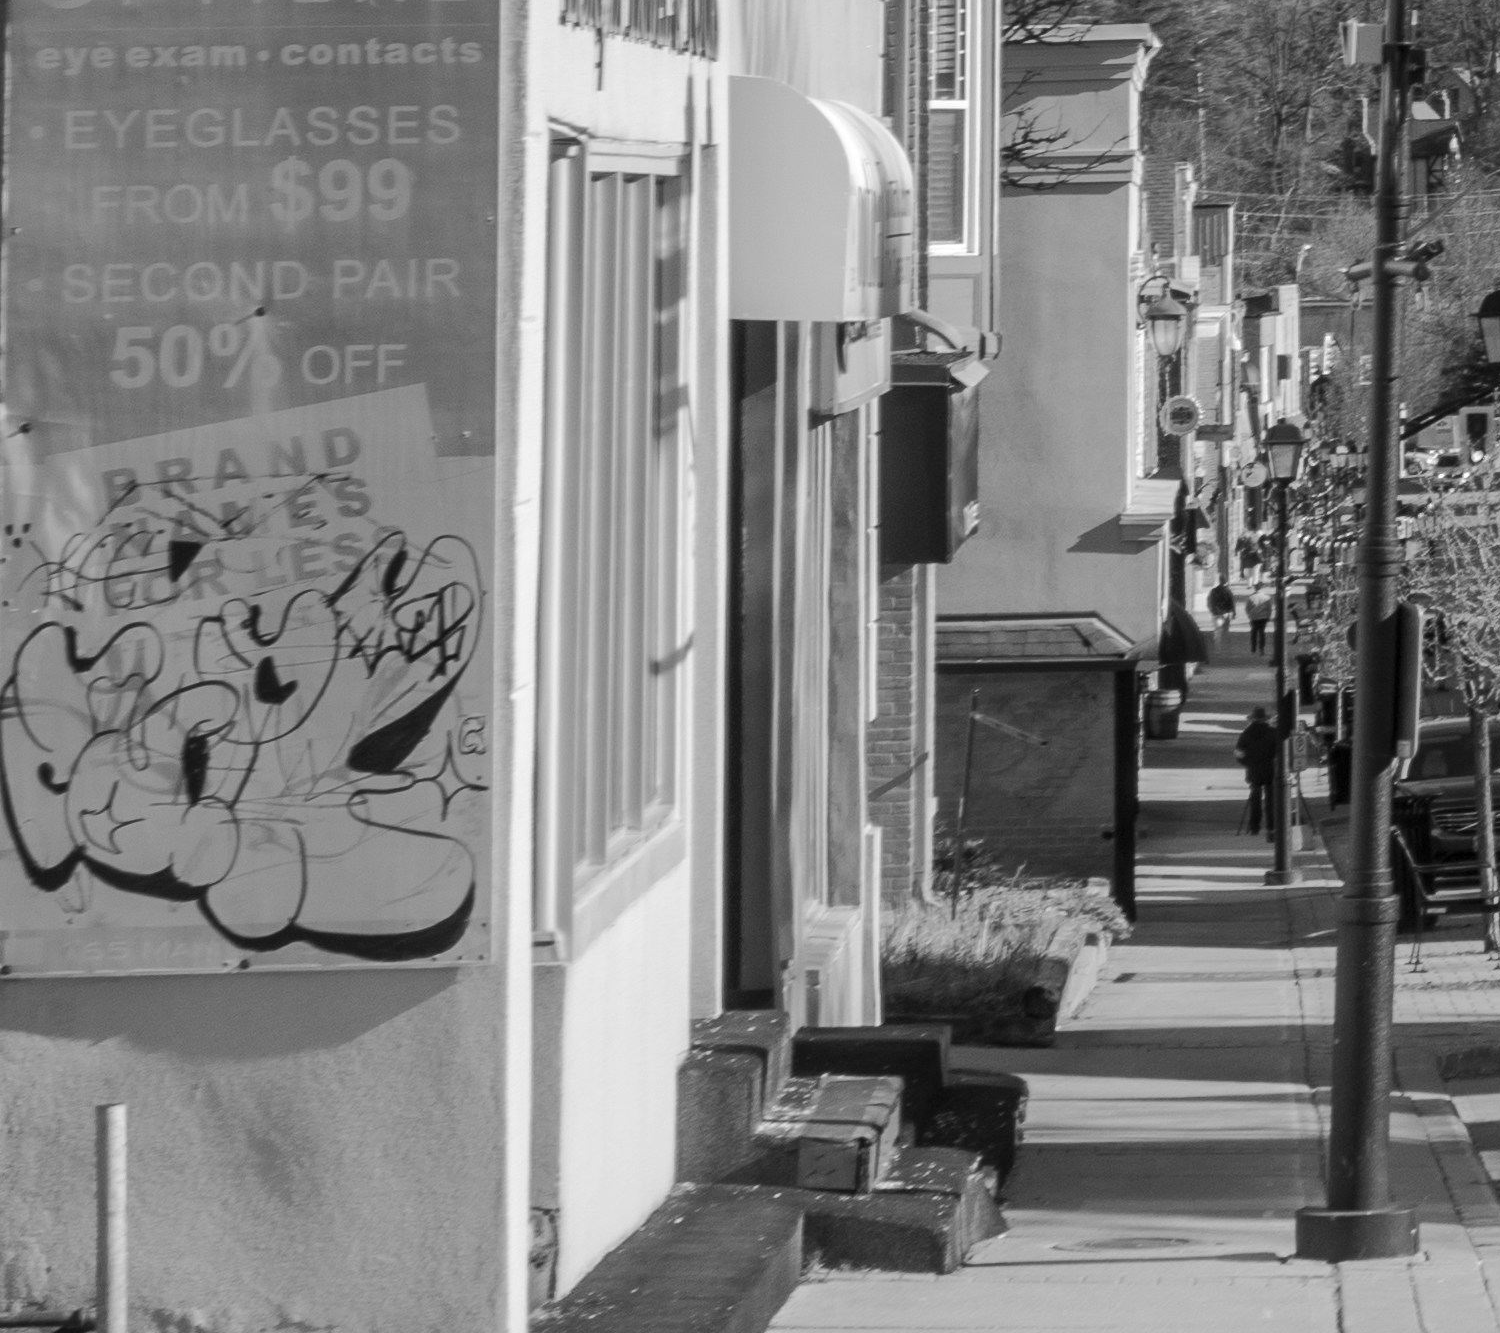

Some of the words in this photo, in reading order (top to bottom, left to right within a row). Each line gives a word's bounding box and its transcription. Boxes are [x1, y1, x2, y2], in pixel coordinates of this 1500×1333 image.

[34, 43, 117, 75] eye
[125, 43, 247, 69] exam
[279, 36, 485, 68] contacts
[64, 104, 463, 150] EYEGLASSES
[91, 183, 250, 226] FROM
[269, 155, 416, 231] $99
[61, 260, 309, 305] SECOND
[332, 257, 465, 300] PAIR
[109, 323, 282, 390] 50%
[301, 344, 409, 385] OFF
[101, 426, 362, 510] BRAND
